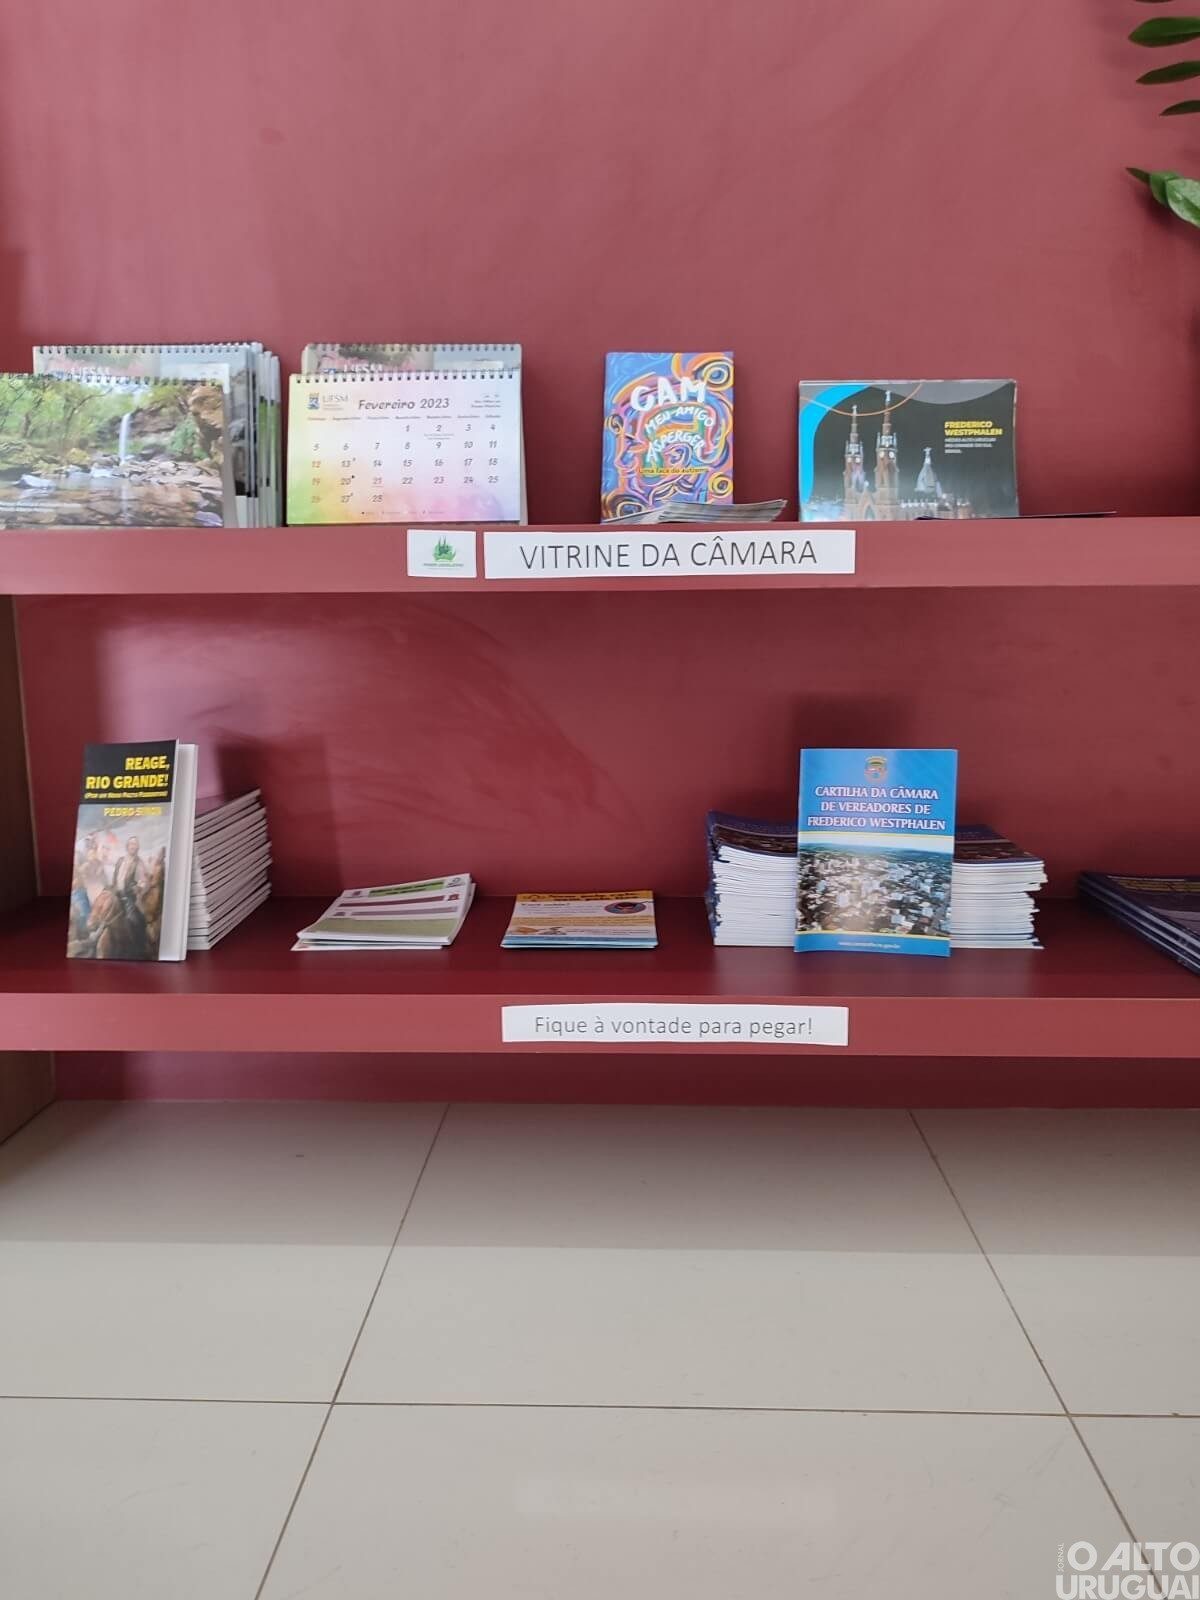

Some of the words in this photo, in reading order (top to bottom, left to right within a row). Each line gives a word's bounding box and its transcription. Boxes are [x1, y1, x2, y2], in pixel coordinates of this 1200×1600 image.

[358, 398, 415, 411] Fevereiro
[420, 397, 450, 409] 2023
[645, 411, 671, 434] MEU
[675, 406, 714, 427] AMIGO
[435, 424, 442, 432] 2
[464, 423, 472, 432] 3
[463, 440, 474, 449] 10
[489, 440, 498, 449] 11
[646, 430, 706, 462] ASPERGER
[403, 459, 413, 468] 15
[463, 458, 473, 467] 17
[401, 476, 414, 485] 22
[433, 475, 445, 485] 23
[488, 475, 499, 484] 25
[519, 544, 630, 569] VITRINE
[642, 543, 680, 567] DA
[690, 535, 817, 566] CÂMARA
[125, 756, 170, 771] REAGE,
[86, 775, 111, 790] RIO
[113, 774, 169, 789] GRANDE!
[815, 786, 868, 798] CARTILHA
[871, 787, 887, 798] DA
[890, 786, 939, 800] CÂMARA
[821, 802, 836, 812] DE
[838, 802, 911, 814] VEREADORES
[915, 804, 931, 815] DE
[808, 816, 866, 828] FREDERICO
[869, 817, 946, 831] WESTPHALEN
[535, 1016, 587, 1036] Fique
[594, 1016, 605, 1033] à
[611, 1016, 692, 1034] vontade
[700, 1021, 742, 1038] para
[750, 1018, 813, 1039] pegar!
